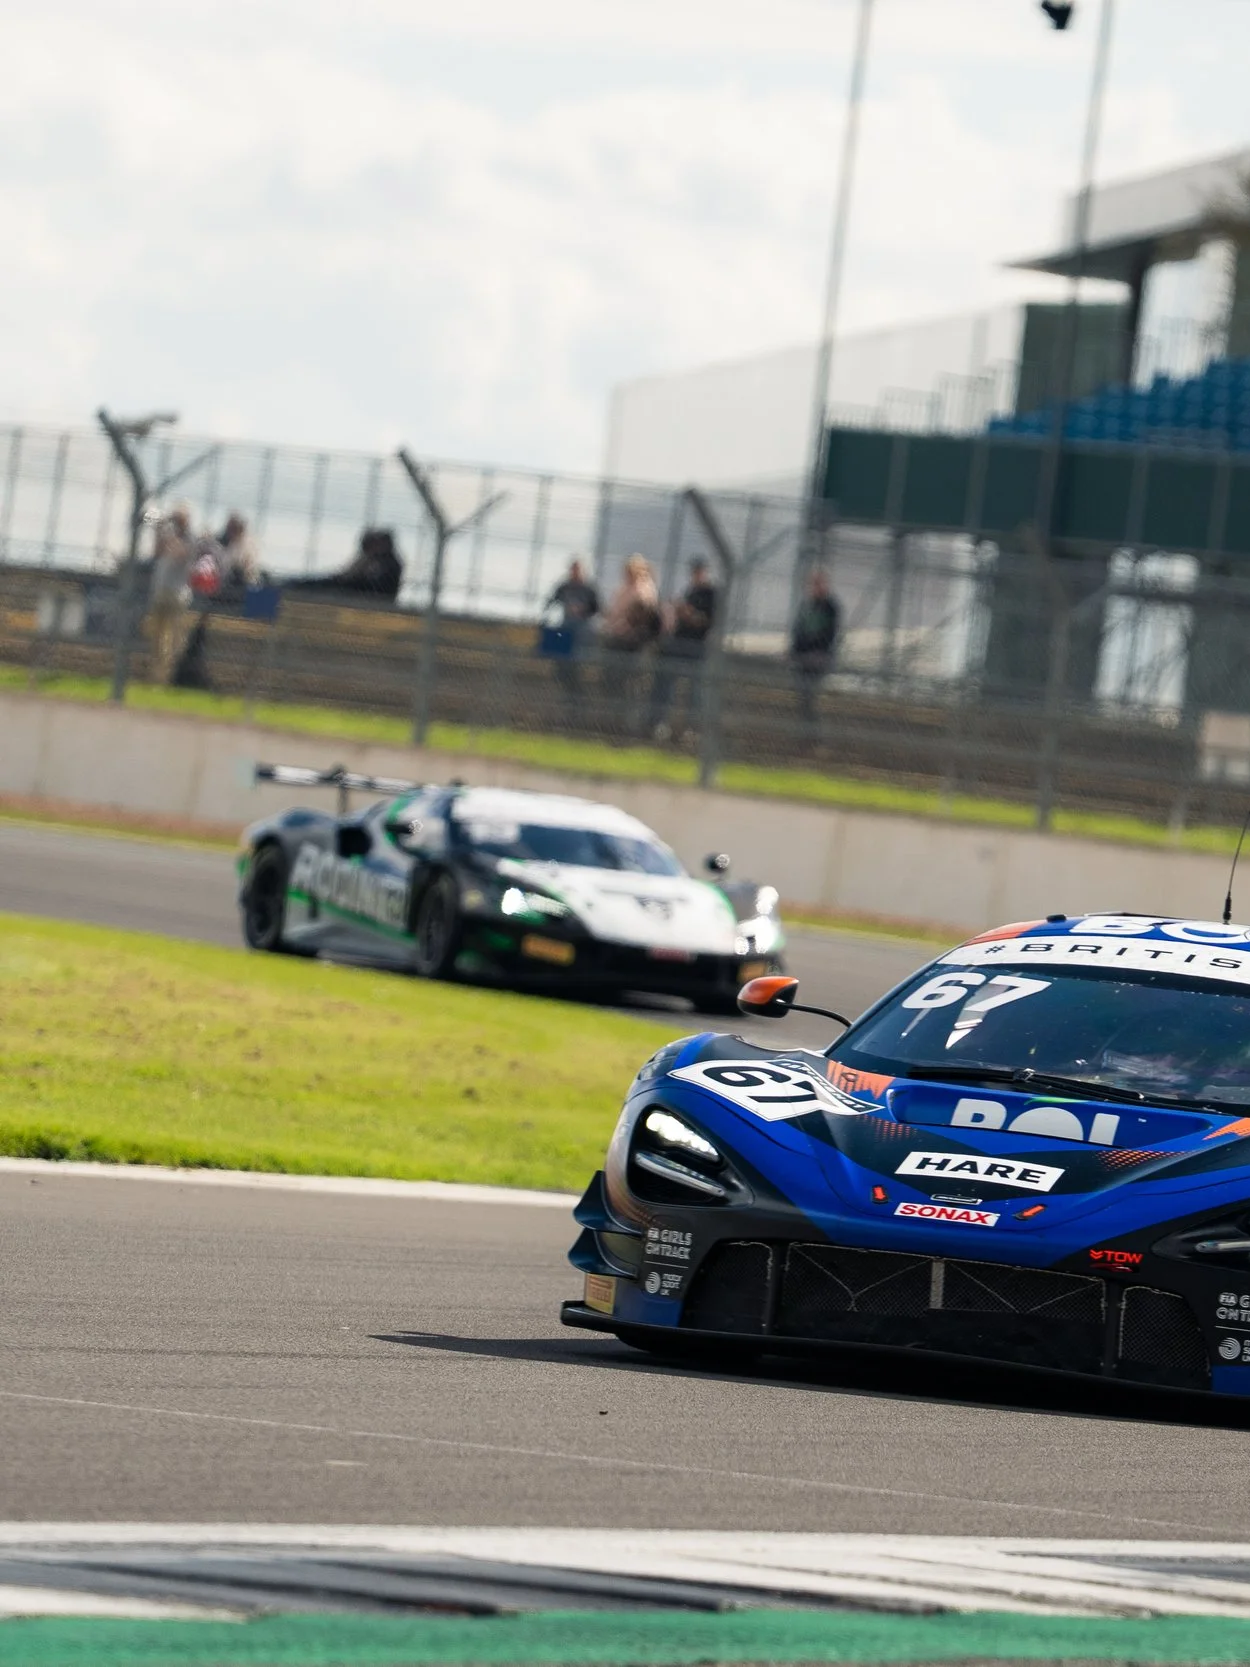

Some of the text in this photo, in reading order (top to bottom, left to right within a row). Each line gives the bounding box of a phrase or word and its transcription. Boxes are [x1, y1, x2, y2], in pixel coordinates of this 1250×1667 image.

[902, 972, 1053, 1050] 67
[702, 1065, 818, 1104] 67
[915, 1156, 1047, 1185] HARE
[898, 1203, 992, 1225] SONAX
[660, 1229, 693, 1246] GIRLS
[1103, 1249, 1144, 1264] TOW
